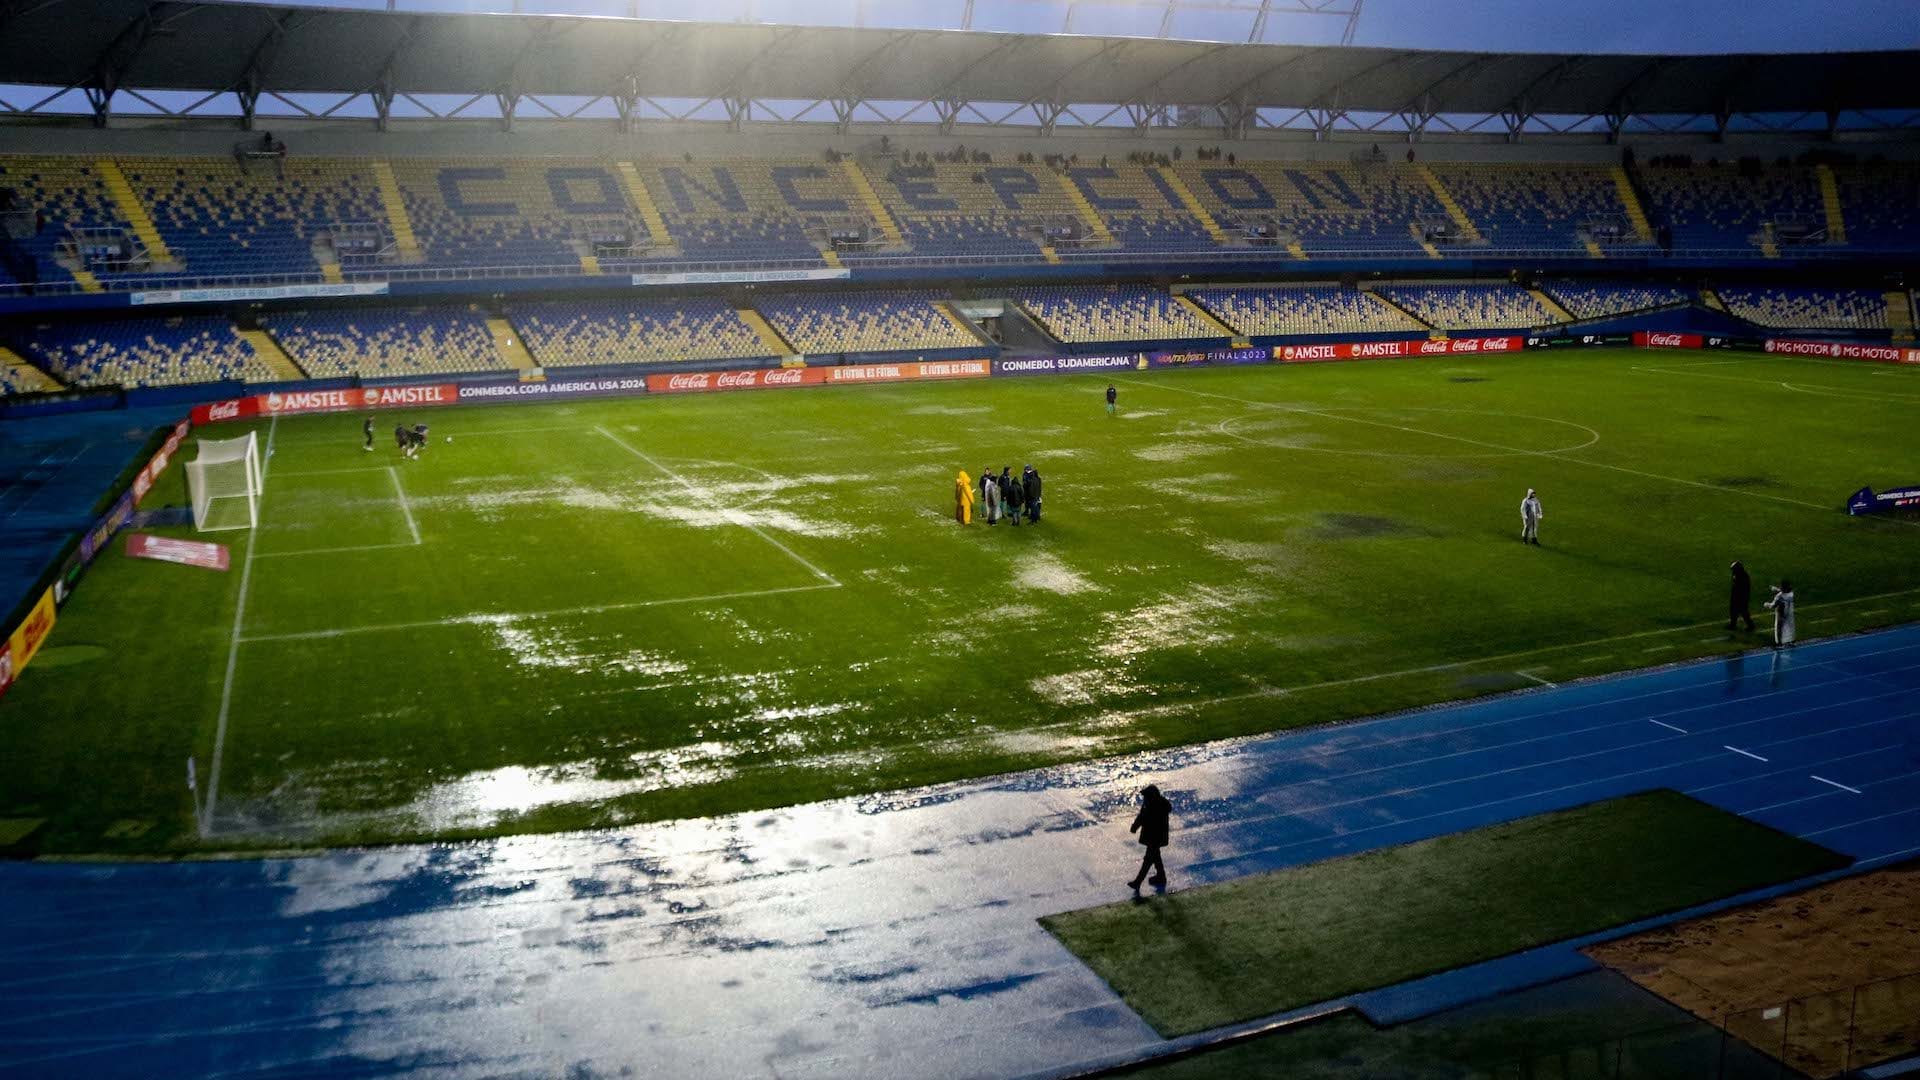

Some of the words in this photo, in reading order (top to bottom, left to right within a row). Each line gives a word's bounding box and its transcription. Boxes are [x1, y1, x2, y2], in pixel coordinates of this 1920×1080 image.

[1207, 352, 1239, 360] FINAL
[1241, 350, 1266, 360] 2023
[1295, 346, 1336, 358] AMSTEL
[1362, 343, 1401, 355] AMSTEL
[1776, 342, 1792, 352] MG
[1793, 343, 1829, 354] MOTOR
[1843, 346, 1860, 357] MG
[1861, 348, 1899, 360] MOTOR
[1002, 358, 1056, 371] CONMEBOL
[1057, 356, 1130, 369] SUDAMERICANA
[380, 386, 443, 403] AMSTEL
[459, 386, 519, 398] CONMEBOL
[519, 383, 548, 395] COPA
[549, 381, 597, 393] AMERICA
[598, 380, 619, 390] USA
[620, 379, 646, 389] 2024
[284, 391, 348, 410] AMSTEL
